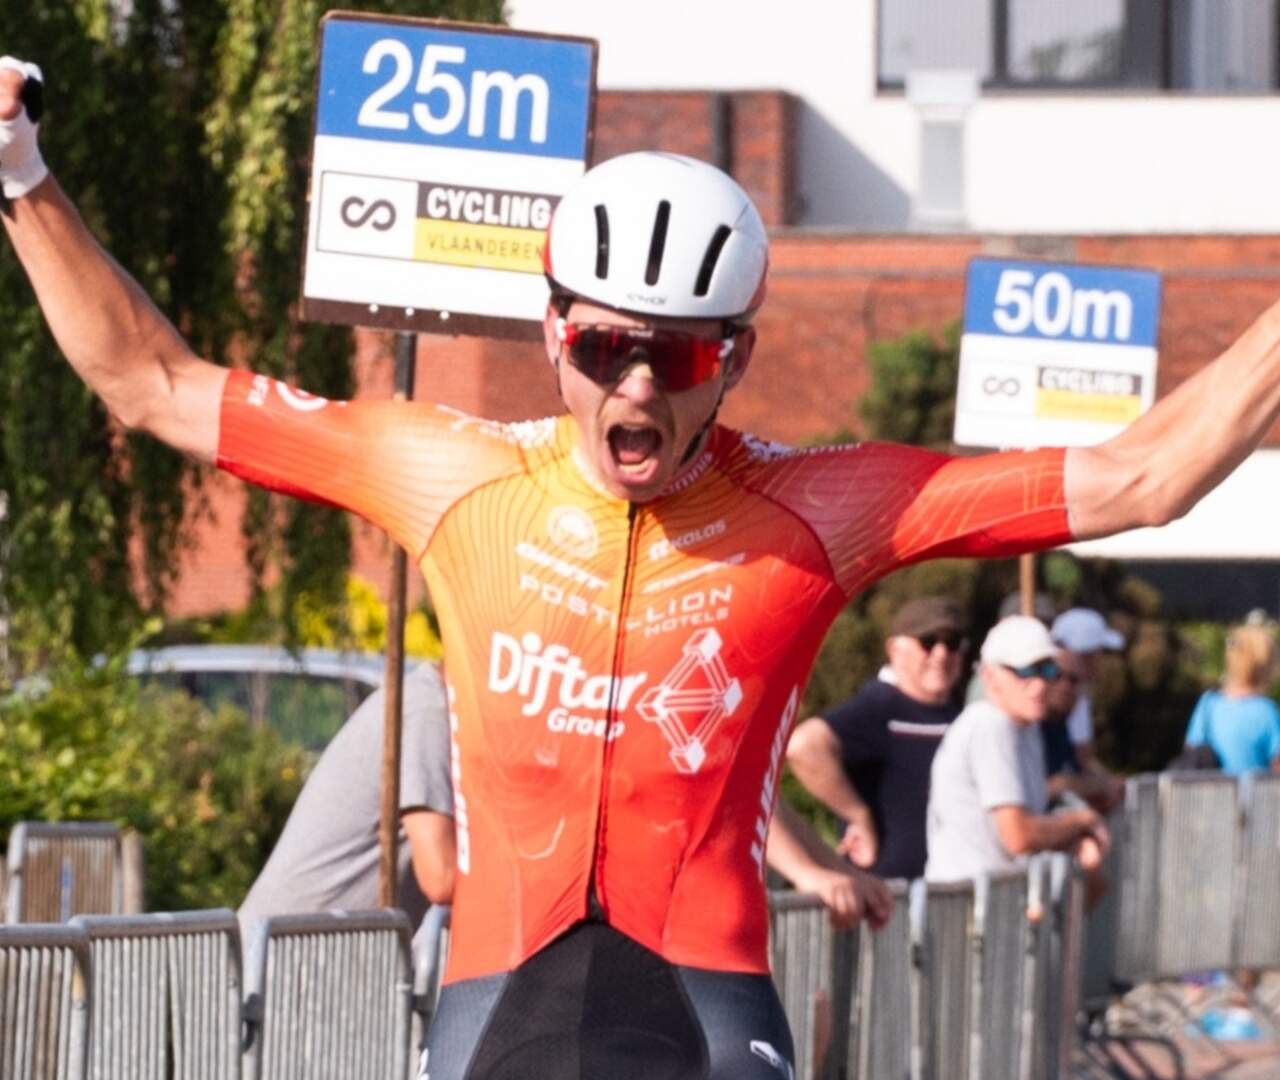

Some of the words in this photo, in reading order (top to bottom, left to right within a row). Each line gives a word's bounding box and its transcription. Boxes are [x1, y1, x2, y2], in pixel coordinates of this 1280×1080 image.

[357, 38, 550, 144] 25m
[426, 187, 552, 230] CYCLING
[992, 269, 1133, 342] 50m
[643, 607, 729, 638] HOTELS
[488, 631, 648, 716] Diftar
